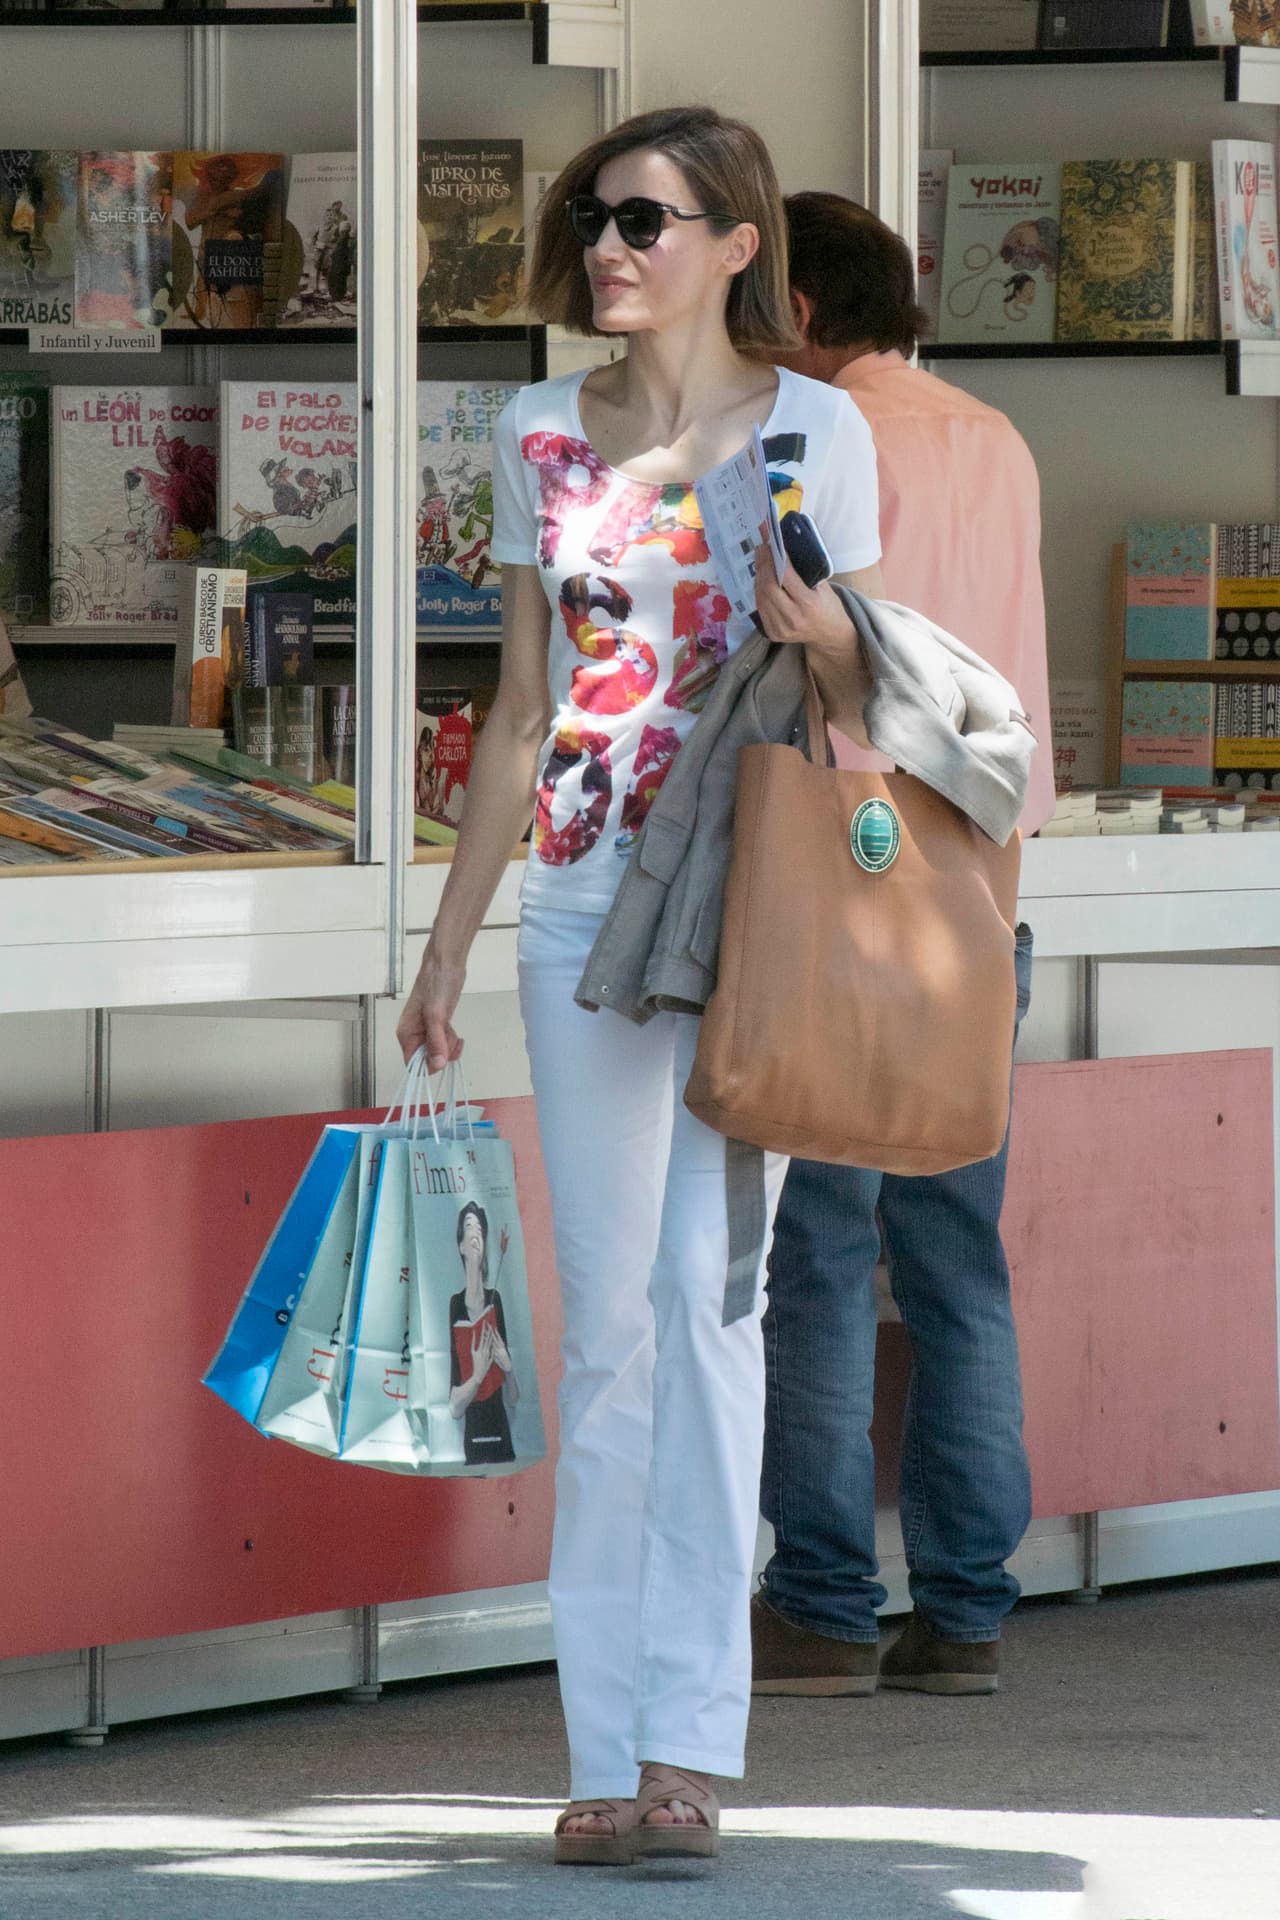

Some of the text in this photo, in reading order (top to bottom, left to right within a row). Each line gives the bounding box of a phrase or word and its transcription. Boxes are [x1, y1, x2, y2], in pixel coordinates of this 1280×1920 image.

[431, 166, 504, 183] LIBRO DE
[424, 183, 512, 206] VISITANTES
[90, 210, 168, 223] ASHER LEV
[209, 255, 220, 266] EL
[223, 255, 250, 266] DON
[209, 266, 247, 278] ASHER
[0, 297, 72, 325] RRABÁS
[40, 334, 156, 352] Infantil y Juvenil
[111, 424, 168, 448] LILA
[200, 577, 209, 589] DE
[205, 573, 219, 654] CRISTIANISMO
[418, 596, 449, 615] Jolly
[451, 596, 487, 615] Roger
[438, 745, 467, 761] CARLOTA
